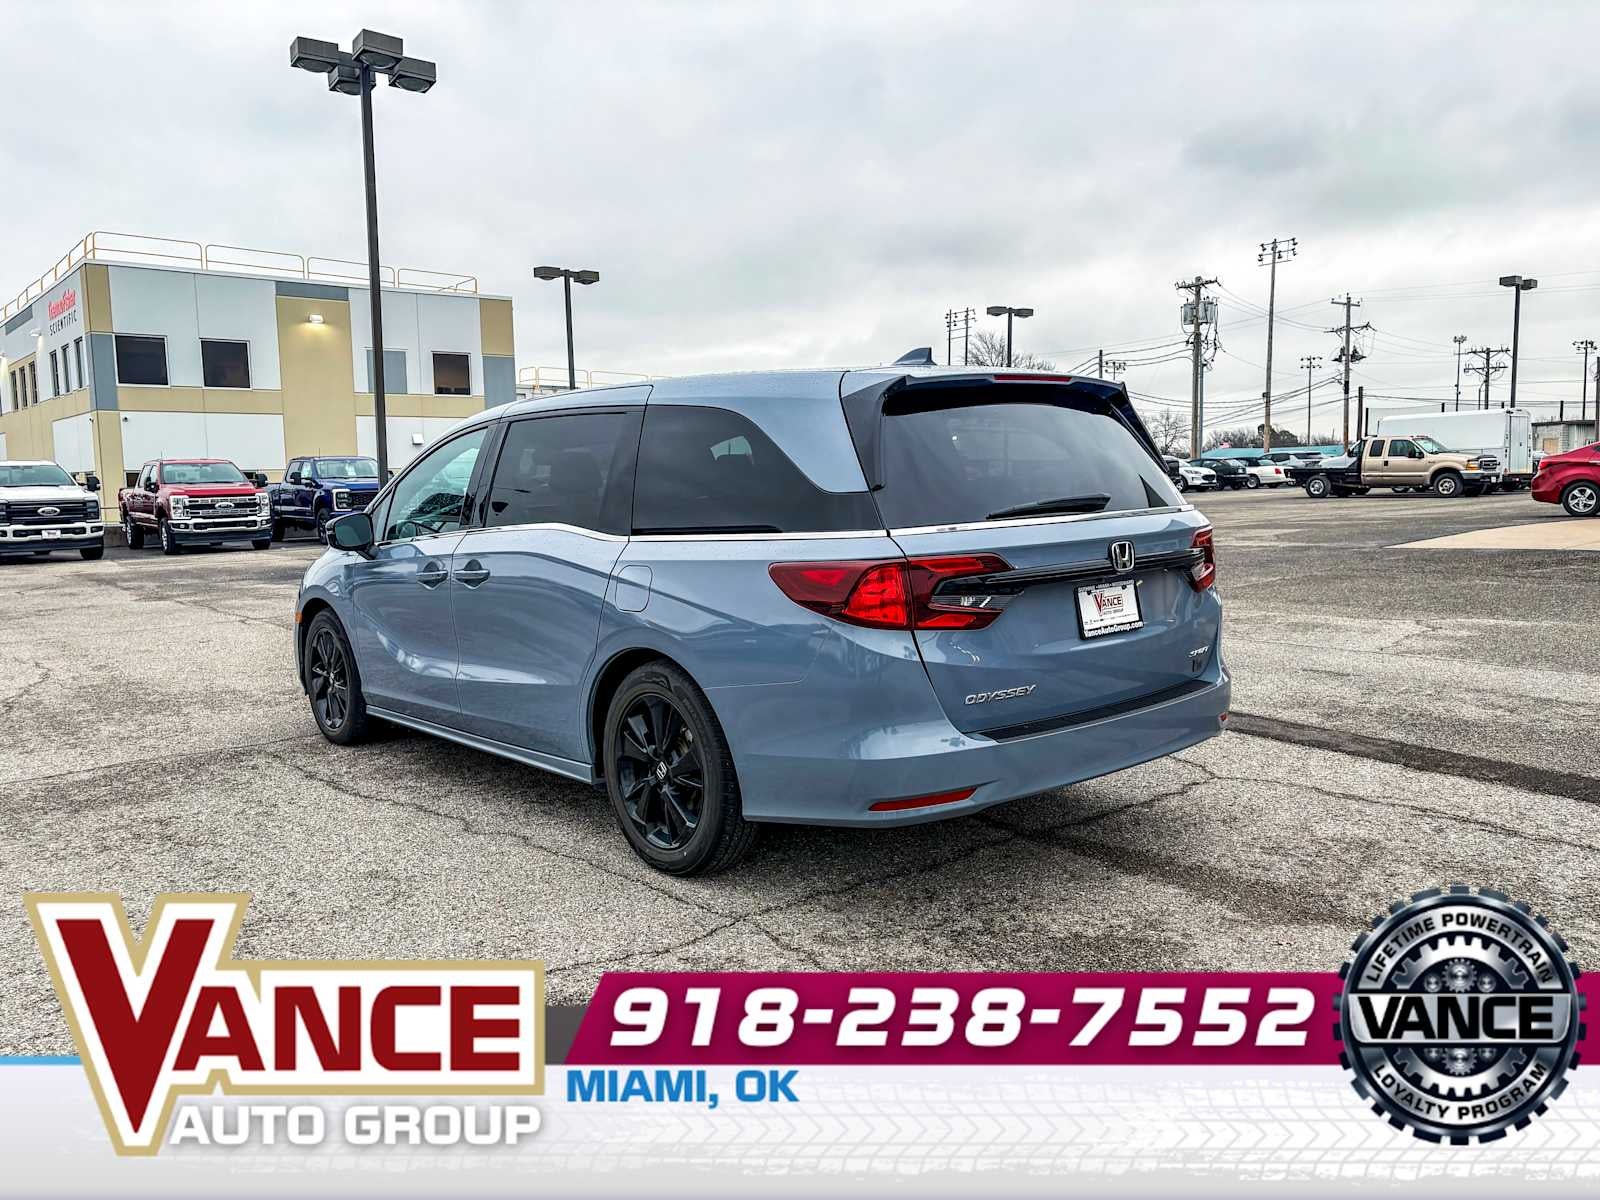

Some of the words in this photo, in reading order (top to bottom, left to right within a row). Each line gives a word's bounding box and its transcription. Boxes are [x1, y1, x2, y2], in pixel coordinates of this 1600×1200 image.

[49, 309, 77, 336] SCIENTIFIC
[1093, 591, 1123, 614] VANCE
[965, 684, 1037, 705] ODYSSEY
